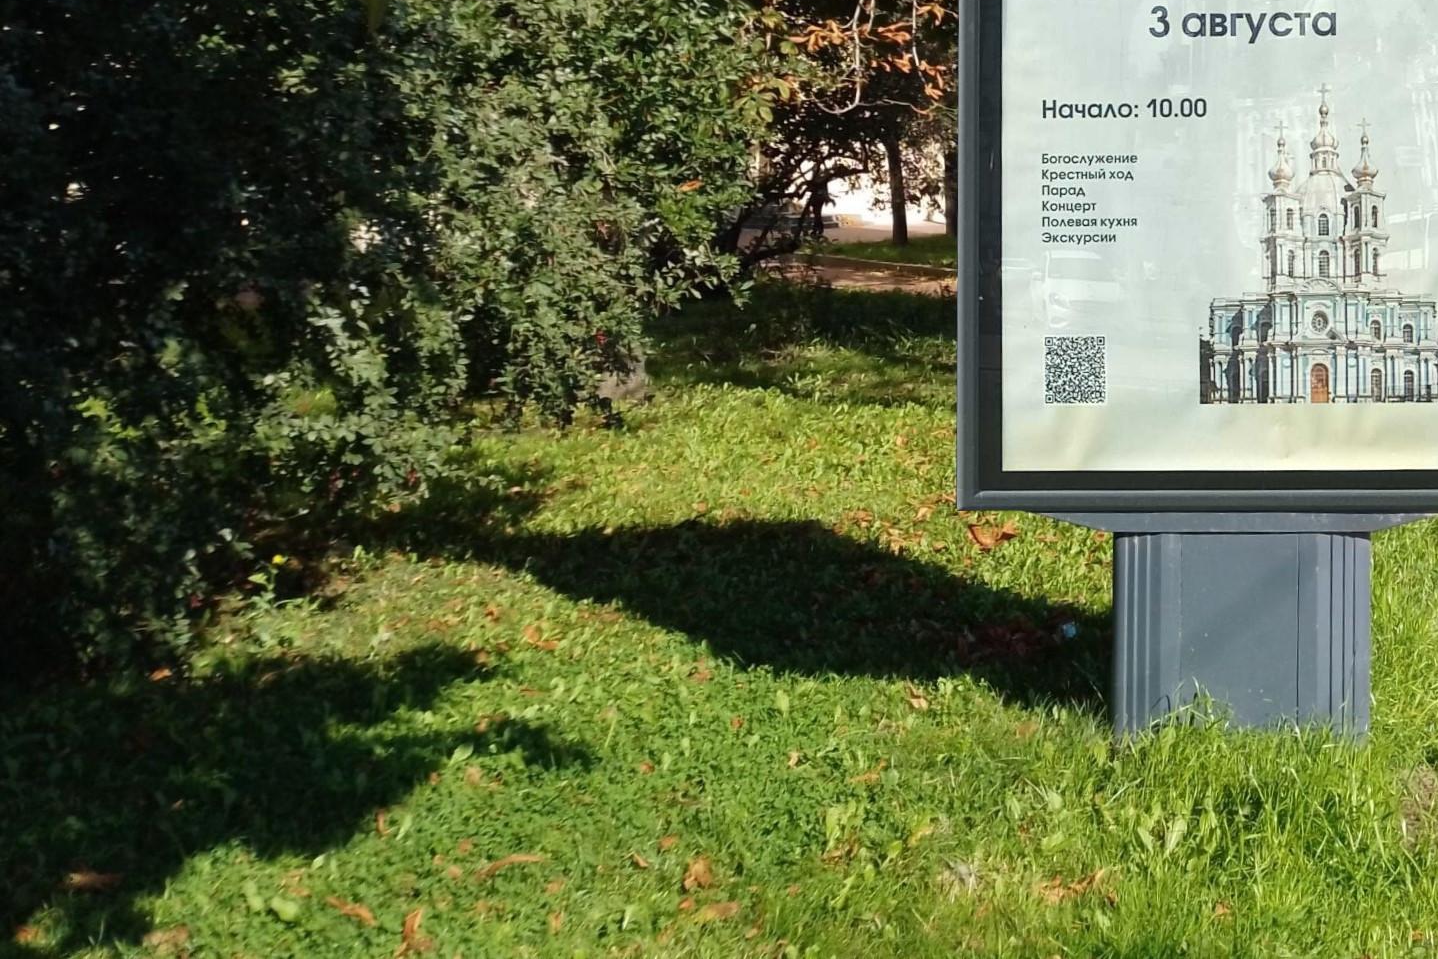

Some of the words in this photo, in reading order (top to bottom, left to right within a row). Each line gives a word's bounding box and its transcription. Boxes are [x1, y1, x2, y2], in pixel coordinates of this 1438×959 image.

[1148, 5, 1171, 38] 3
[1181, 11, 1337, 44] августа
[1042, 99, 1139, 119] Начало:
[1146, 98, 1207, 118] 10.00
[1041, 153, 1138, 166] Богослужение
[1041, 168, 1106, 182] Крестный
[1109, 171, 1134, 181] ход
[1041, 185, 1086, 197] Парад
[1041, 201, 1097, 213] Концерт
[1041, 216, 1097, 228] Полевая
[1100, 218, 1138, 229] кухня
[1041, 232, 1117, 245] Экскурсии
